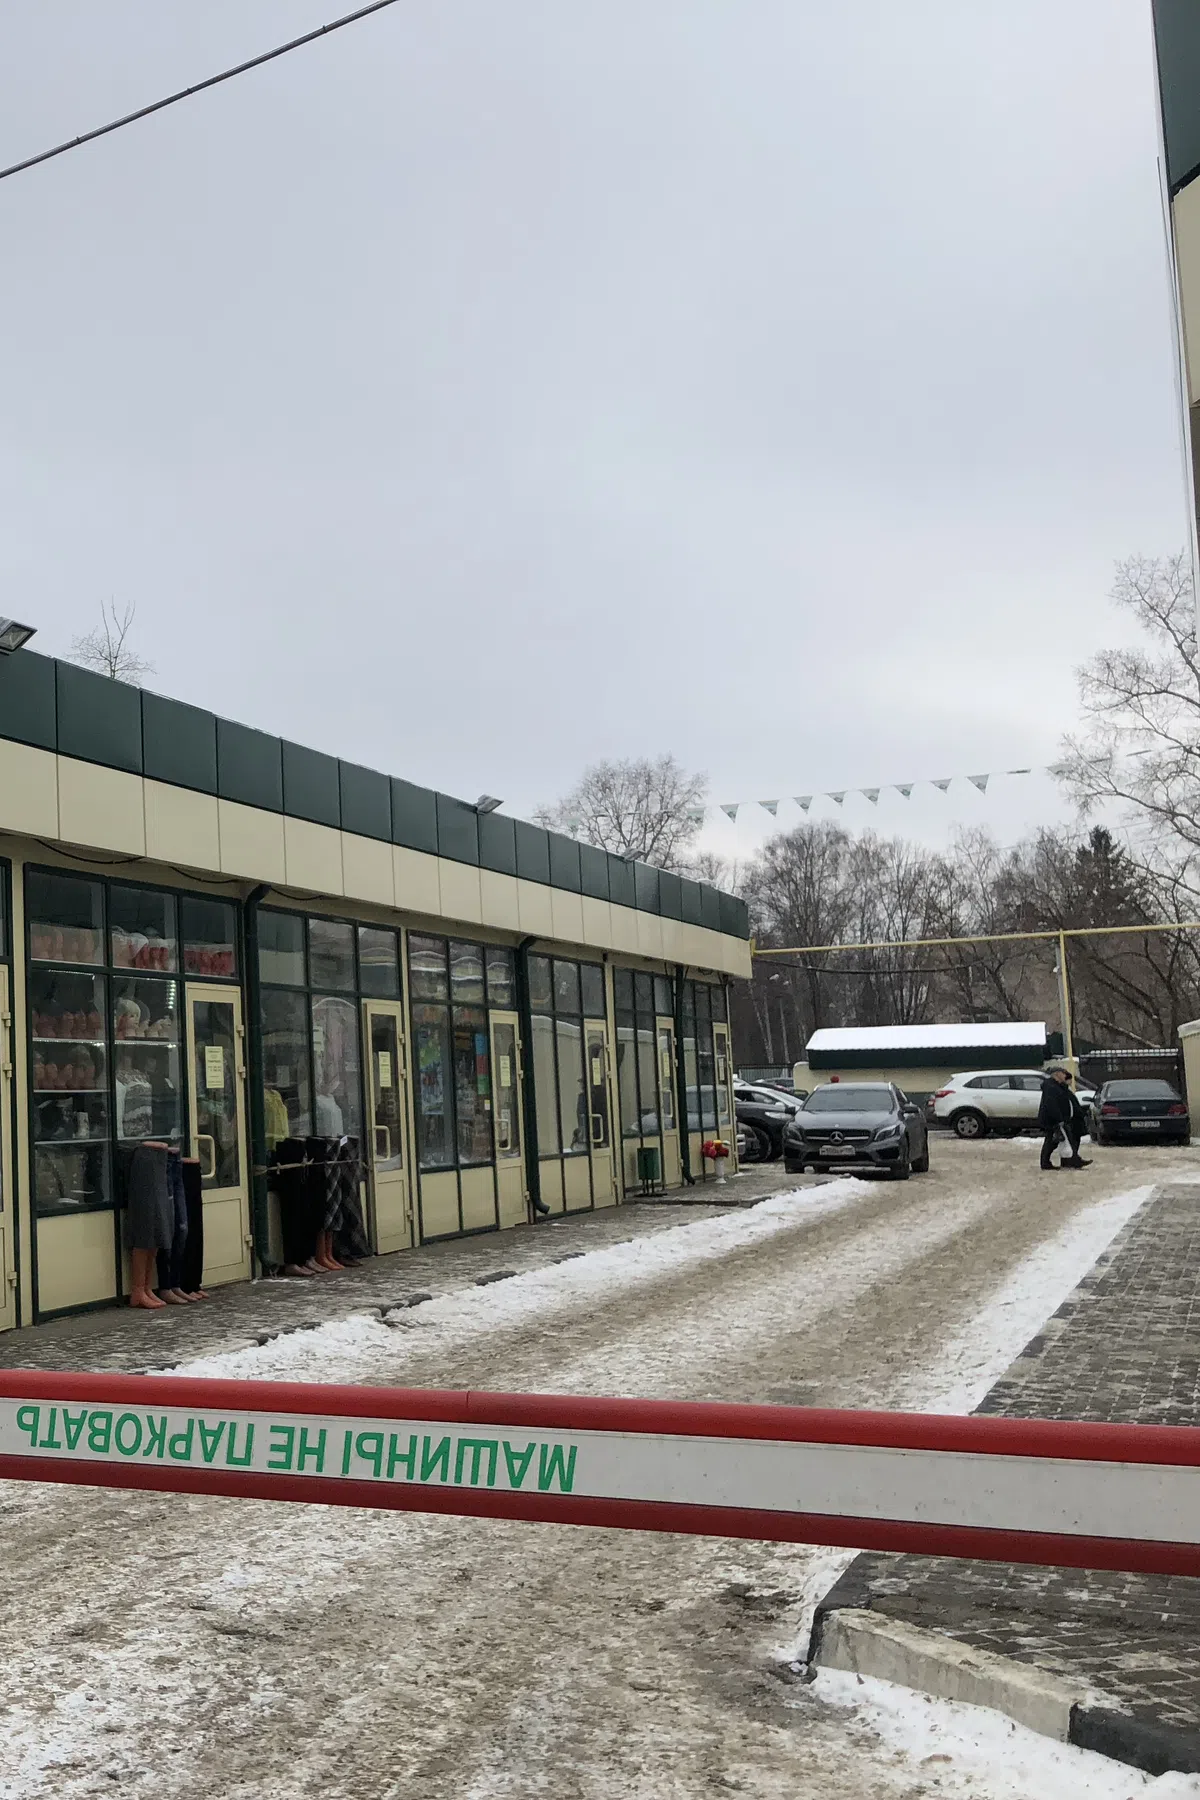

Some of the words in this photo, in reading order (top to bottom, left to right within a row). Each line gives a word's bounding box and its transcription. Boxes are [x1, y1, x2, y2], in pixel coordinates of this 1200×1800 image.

[16, 1404, 256, 1466] ПАРКОВАТЬ
[268, 1425, 327, 1472] НЕ
[341, 1430, 578, 1492] МАШИНЫ
